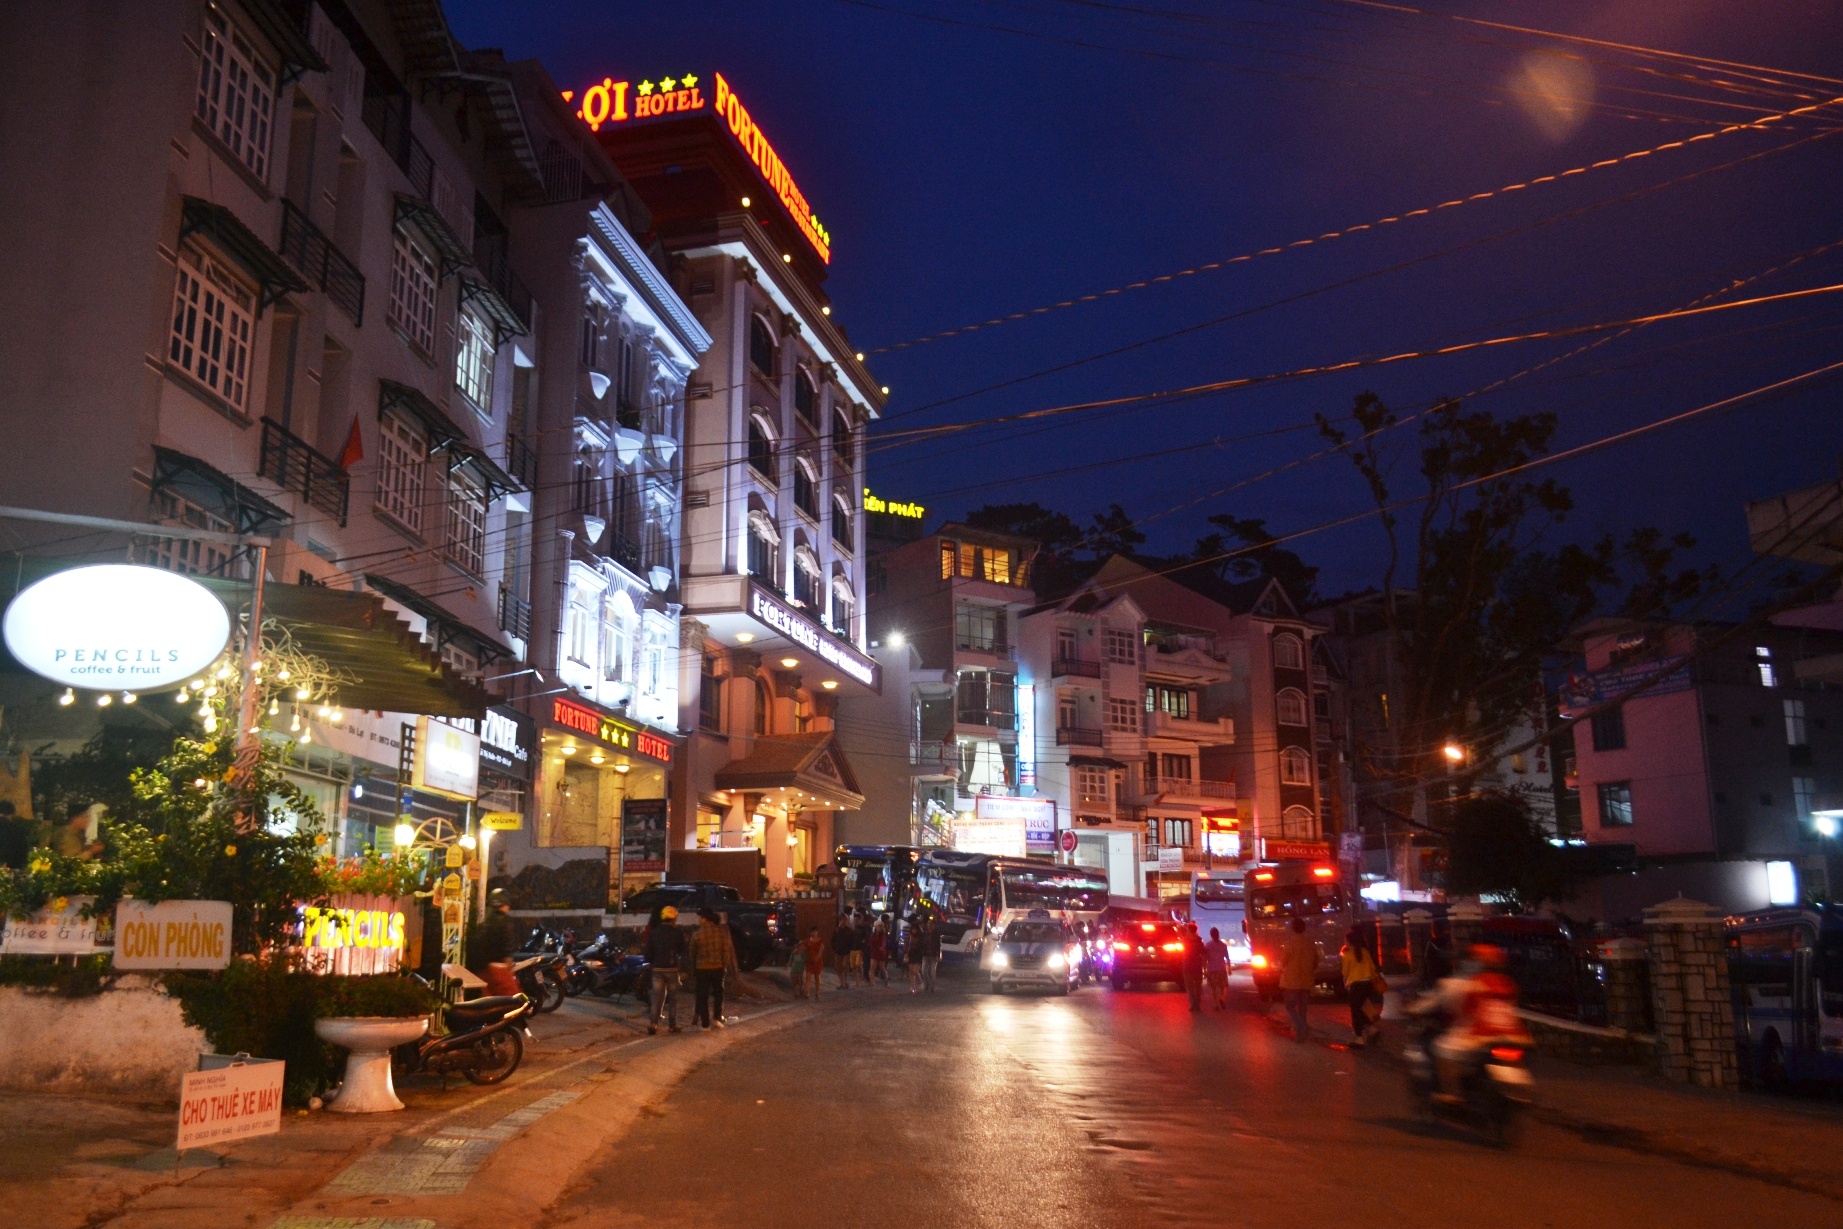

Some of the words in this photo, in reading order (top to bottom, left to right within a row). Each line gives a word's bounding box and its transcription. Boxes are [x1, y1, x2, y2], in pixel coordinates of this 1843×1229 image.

[562, 77, 628, 131] ỢI
[635, 88, 704, 117] HOTEL
[714, 72, 791, 208] FORTUNE
[889, 503, 925, 519] PHÁT
[753, 592, 819, 652] FORTUNE
[54, 649, 179, 662] PENCILS
[70, 665, 113, 674] coffee
[117, 665, 126, 674] &
[130, 665, 161, 674] fruit
[553, 702, 598, 736] FORTUNE
[637, 734, 671, 762] HOTEL
[490, 816, 518, 825] Welcome
[1025, 816, 1050, 829] RÚC
[847, 859, 862, 868] VIP
[58, 926, 71, 940] &
[123, 911, 161, 958] CÒN
[165, 911, 224, 959] PHÒNG
[182, 1097, 208, 1126] CHO
[211, 1086, 240, 1121] THUÊ
[241, 1090, 257, 1116] XE
[258, 1081, 281, 1113] MÁY
